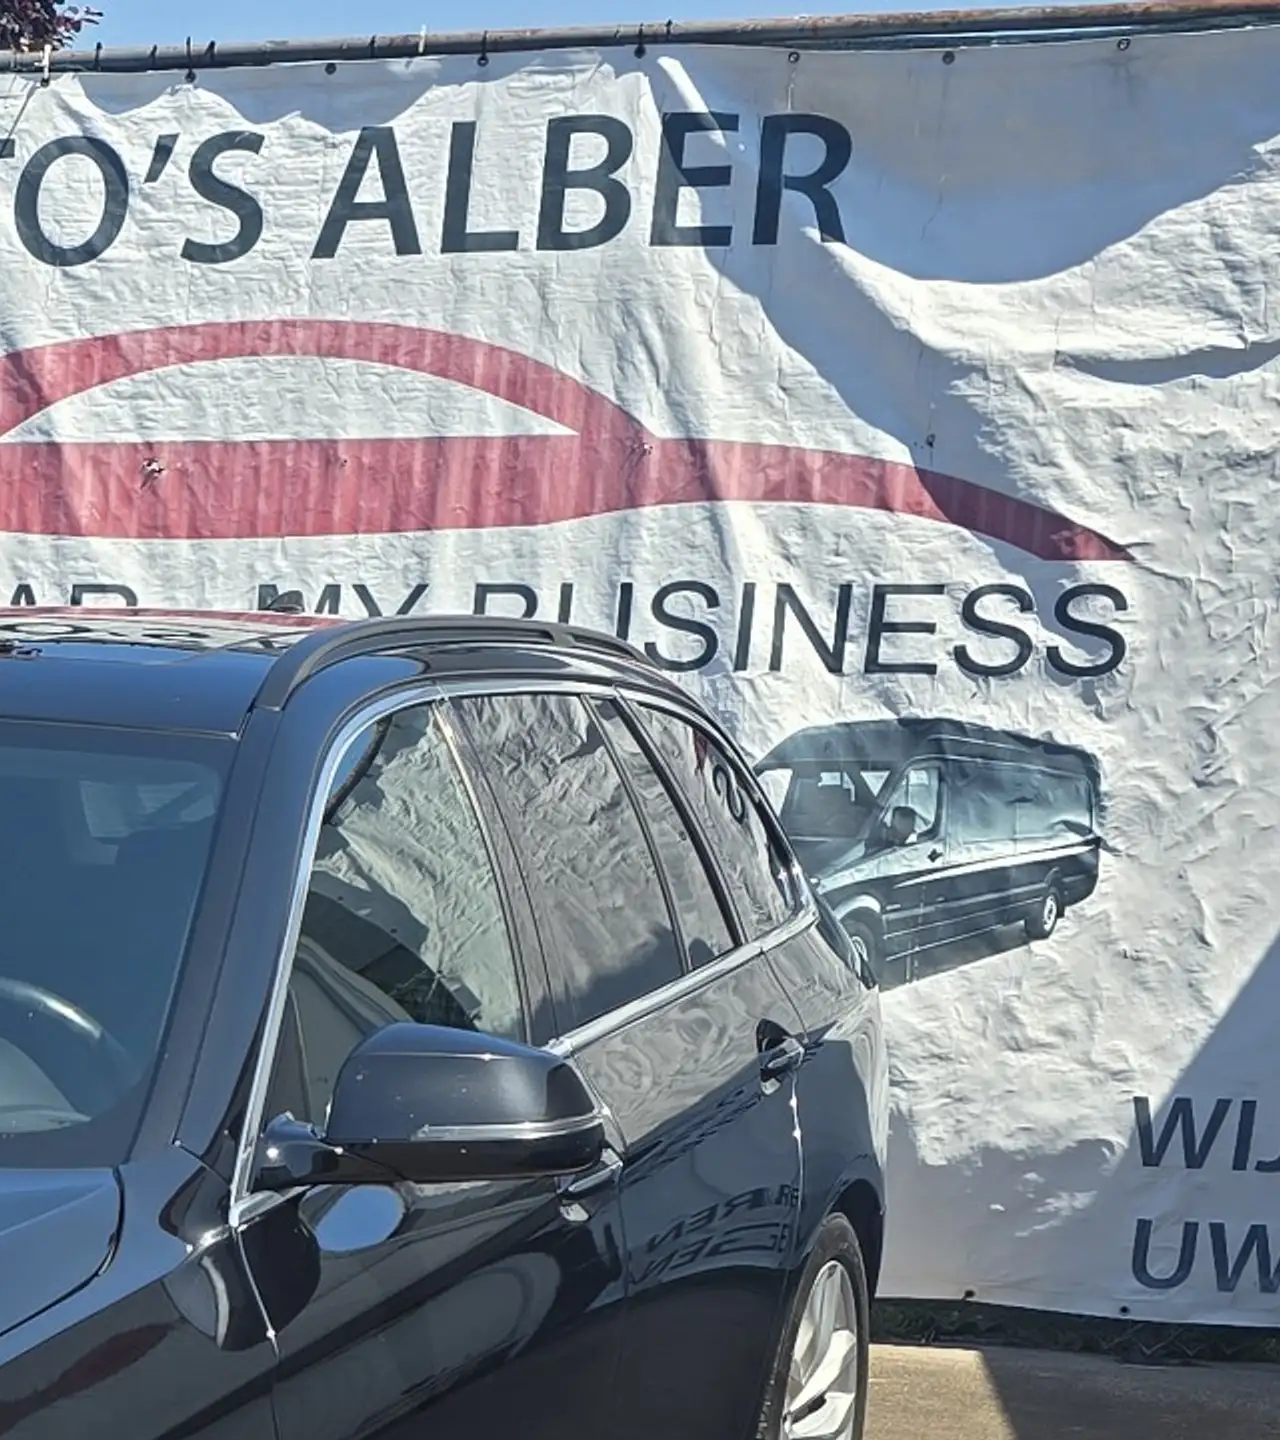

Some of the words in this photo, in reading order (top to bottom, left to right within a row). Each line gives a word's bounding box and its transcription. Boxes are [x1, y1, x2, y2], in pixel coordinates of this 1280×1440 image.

[310, 112, 853, 259] ALBER
[1133, 1096, 1280, 1173] WI
[1132, 1218, 1280, 1294] UW
